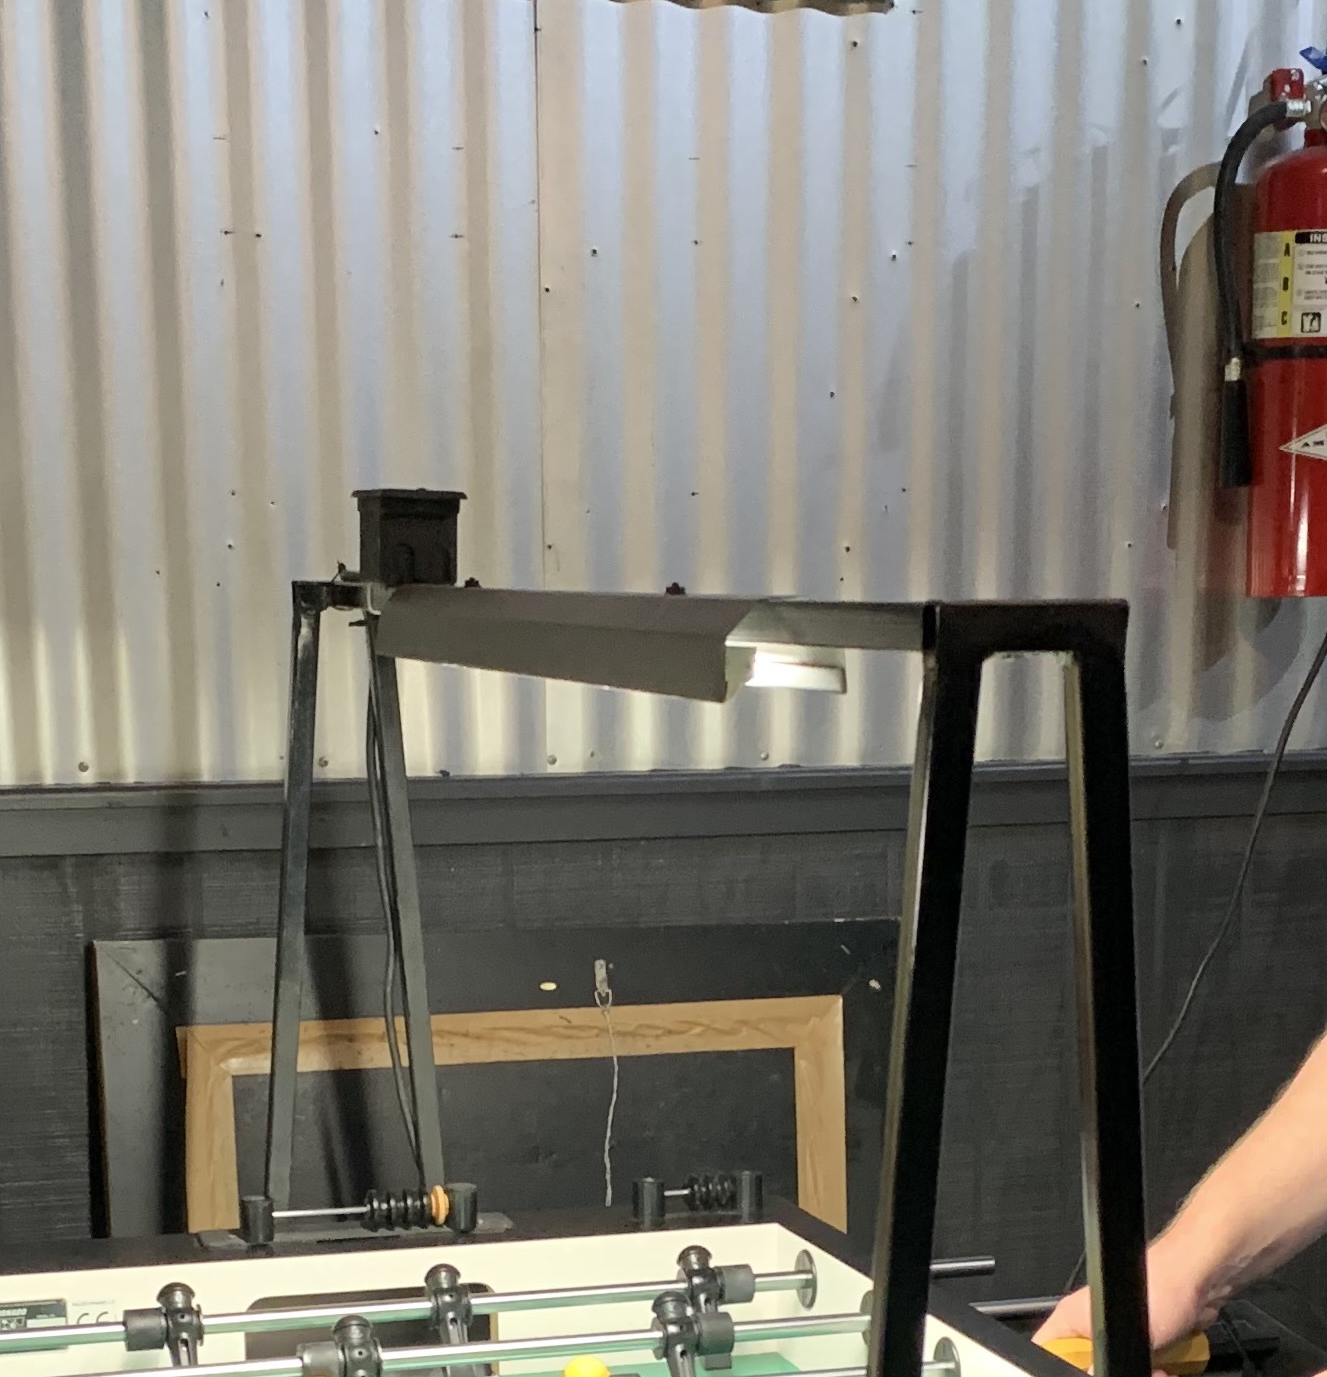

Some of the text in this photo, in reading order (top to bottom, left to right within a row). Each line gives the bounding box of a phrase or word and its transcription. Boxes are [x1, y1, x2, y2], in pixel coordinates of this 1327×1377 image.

[1283, 243, 1290, 257] A
[1282, 276, 1290, 291] B
[1281, 311, 1288, 325] C
